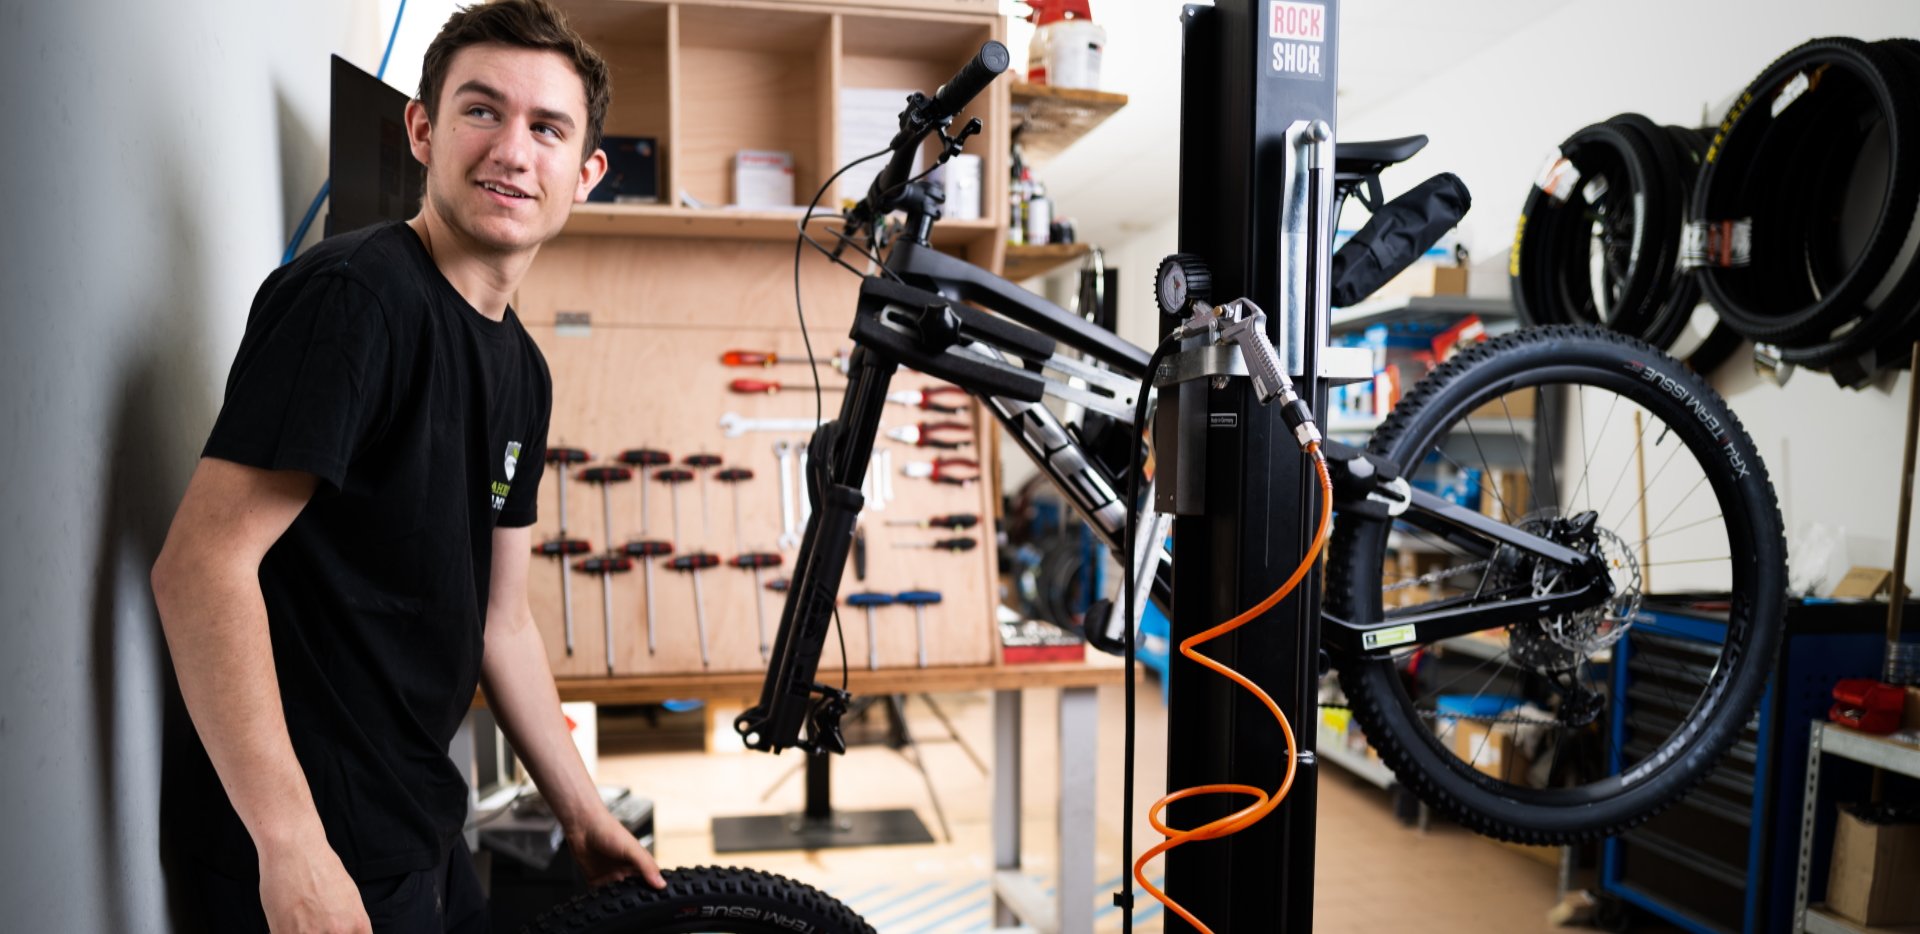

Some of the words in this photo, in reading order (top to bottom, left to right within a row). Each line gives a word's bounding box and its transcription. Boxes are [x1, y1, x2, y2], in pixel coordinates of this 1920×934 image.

[1274, 5, 1320, 37] ROCK
[1272, 42, 1320, 74] SHOX
[1641, 366, 1690, 400] ISSUE
[1686, 396, 1725, 440] TEAM
[1724, 442, 1750, 479] XR4
[701, 905, 761, 919] ISSUE
[762, 911, 815, 934] TEAM
